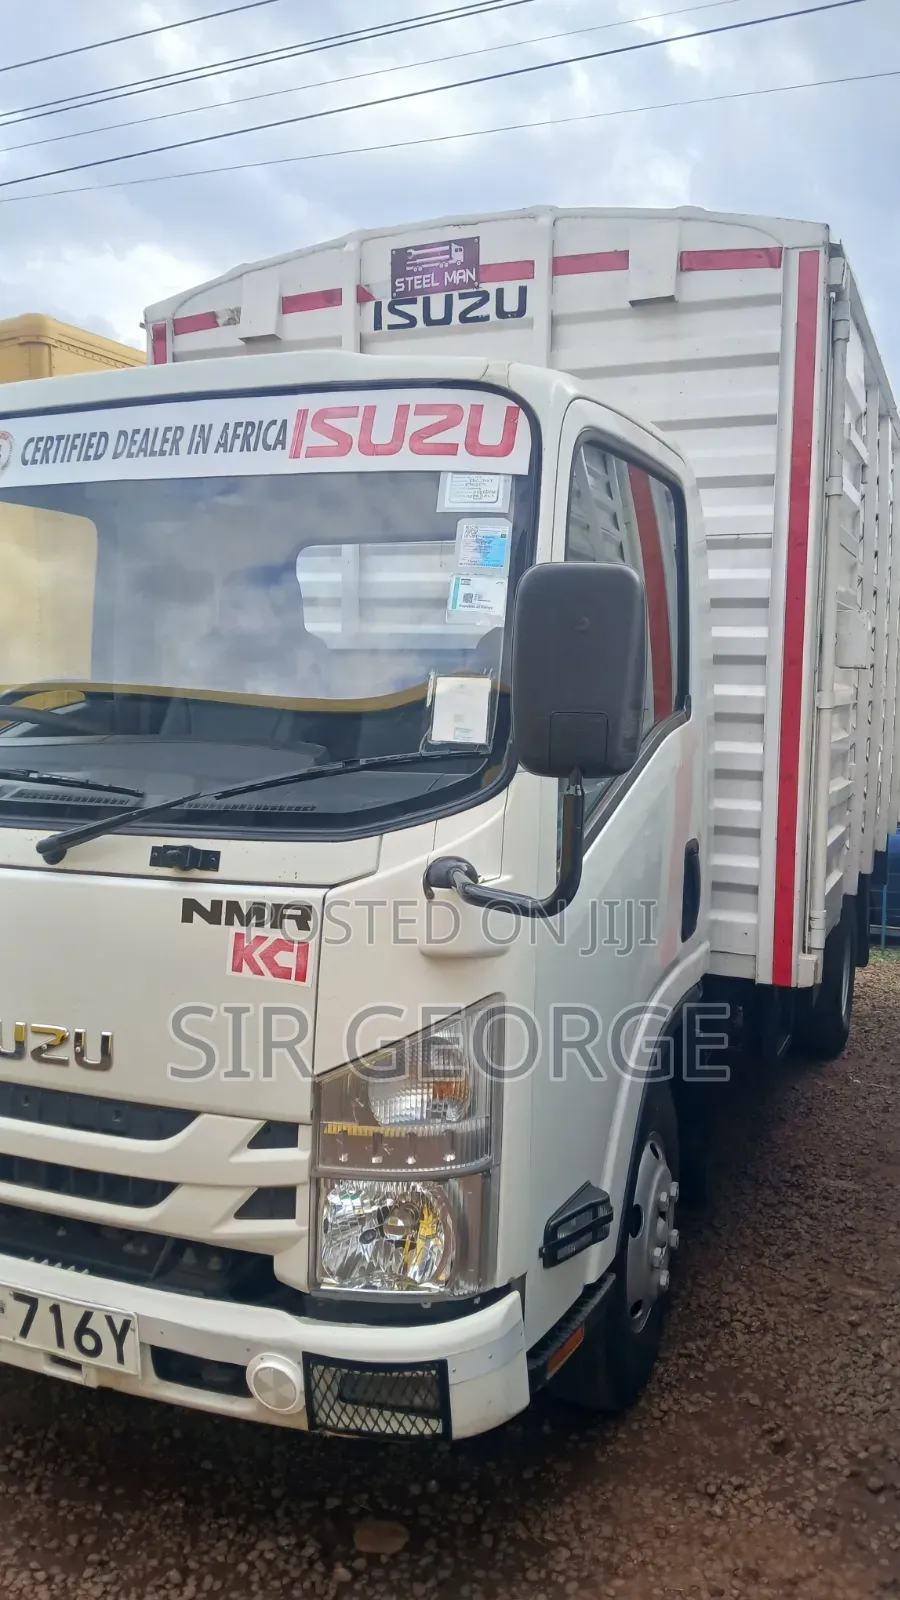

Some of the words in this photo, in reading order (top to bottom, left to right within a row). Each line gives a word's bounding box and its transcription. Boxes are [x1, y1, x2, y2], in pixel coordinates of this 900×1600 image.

[394, 272, 440, 293] STEEL
[444, 267, 476, 286] MAN
[373, 285, 528, 331] ISUZU
[20, 431, 110, 466] CERTIFIED
[111, 425, 185, 460] DEALER
[187, 423, 213, 456] IN
[214, 418, 288, 454] AFRICA
[288, 403, 521, 459] ISUZU
[181, 897, 313, 932] NMR
[231, 932, 310, 983] KCI
[12, 1290, 132, 1366] 716Y
